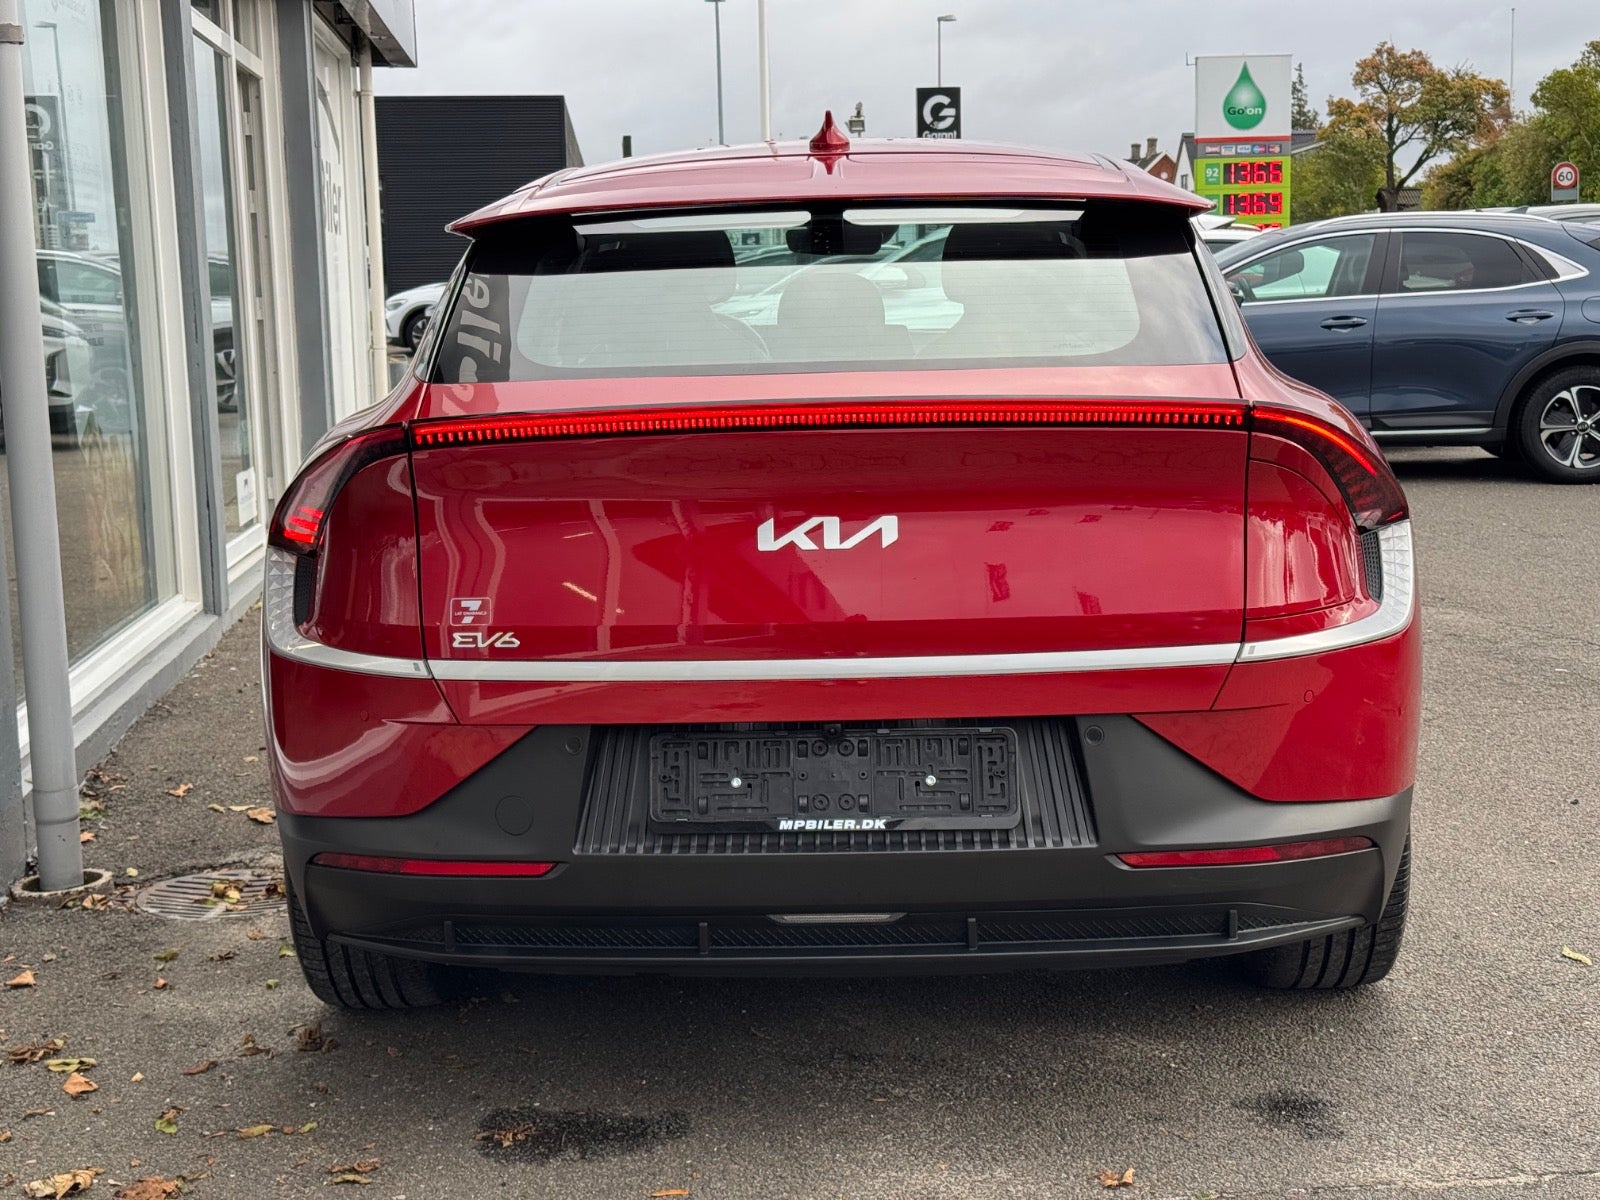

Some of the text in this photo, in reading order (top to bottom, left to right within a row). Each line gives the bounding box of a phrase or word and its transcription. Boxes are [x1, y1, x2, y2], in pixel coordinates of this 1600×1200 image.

[1227, 106, 1262, 116] Go'on
[1206, 167, 1219, 178] 92
[1557, 171, 1574, 182] 60
[757, 515, 899, 552] KIA
[460, 600, 482, 624] 7
[452, 632, 521, 648] EV6
[778, 819, 887, 831] MPBILER.DK
